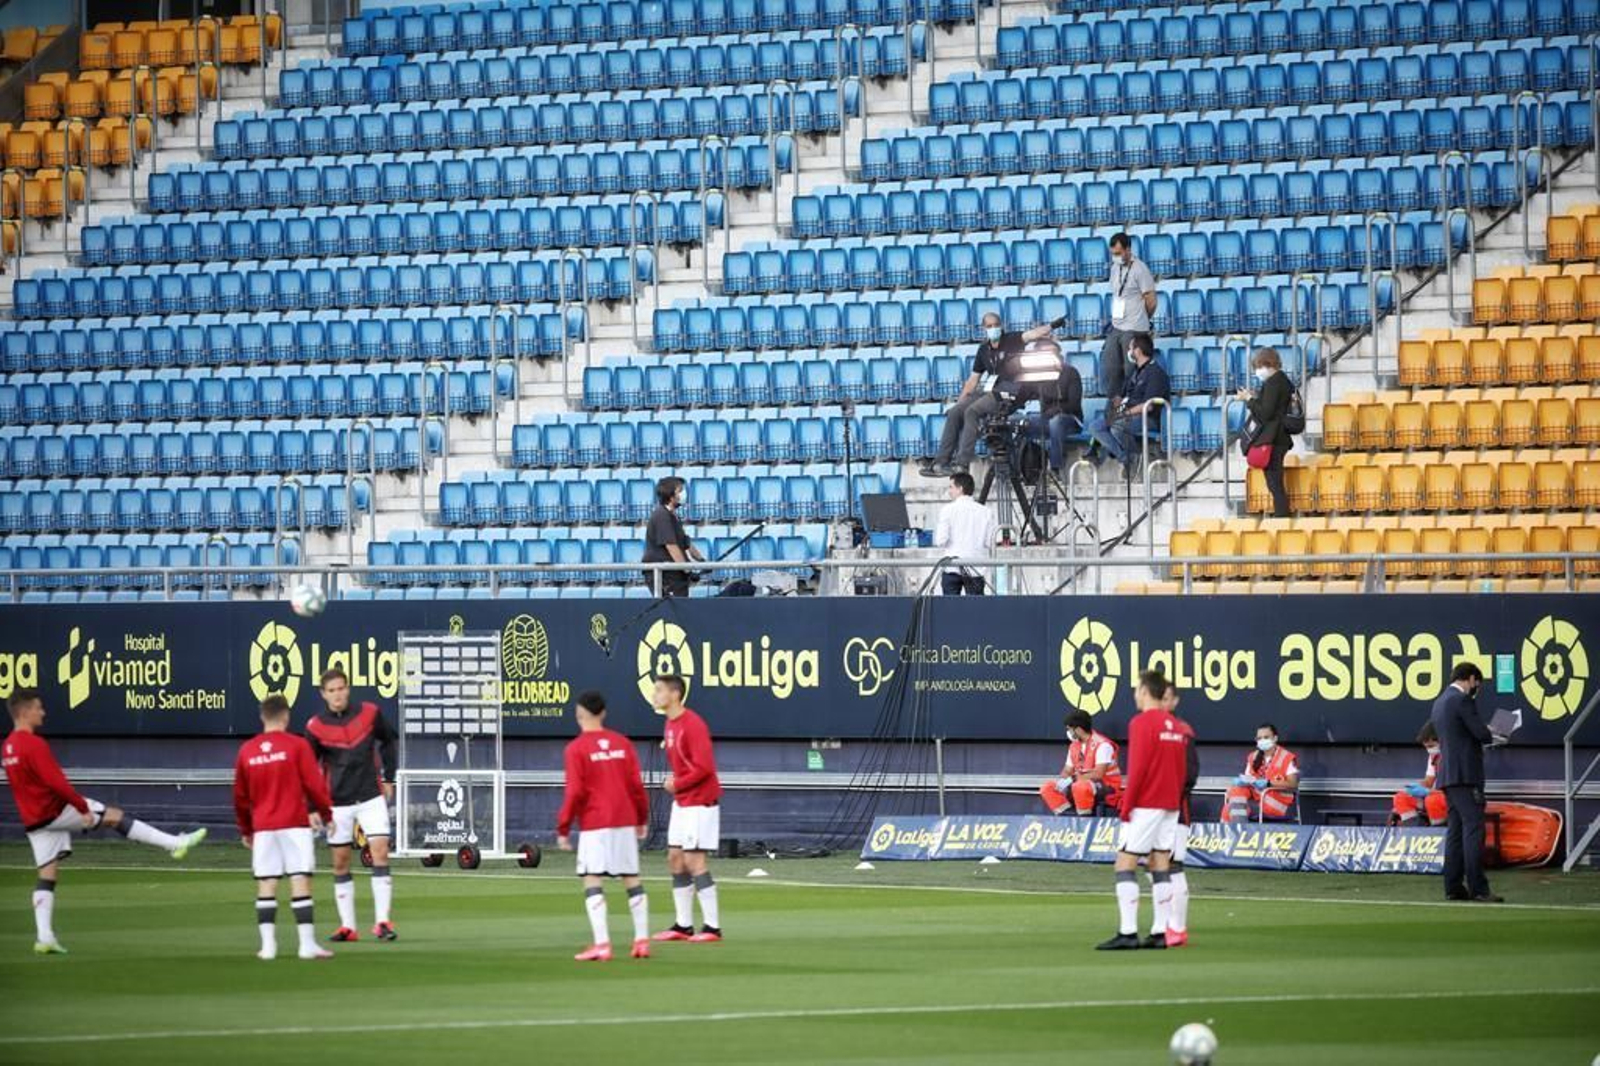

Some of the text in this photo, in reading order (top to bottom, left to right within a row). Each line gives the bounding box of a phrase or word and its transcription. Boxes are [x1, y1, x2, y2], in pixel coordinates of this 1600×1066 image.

[124, 632, 165, 654] Hospital
[94, 649, 171, 686] viamed
[311, 637, 421, 698] LaLig
[702, 635, 819, 699] LaLiga
[941, 644, 980, 664] Dental
[983, 645, 1032, 669] Copano
[1130, 634, 1255, 701] LaLiga
[1279, 633, 1442, 700] asisa
[126, 689, 226, 710] Novo Sancti Petri
[946, 823, 1008, 841] LA VOZ
[1236, 831, 1298, 850] LA VOZ
[1384, 835, 1443, 854] LA VOZ
